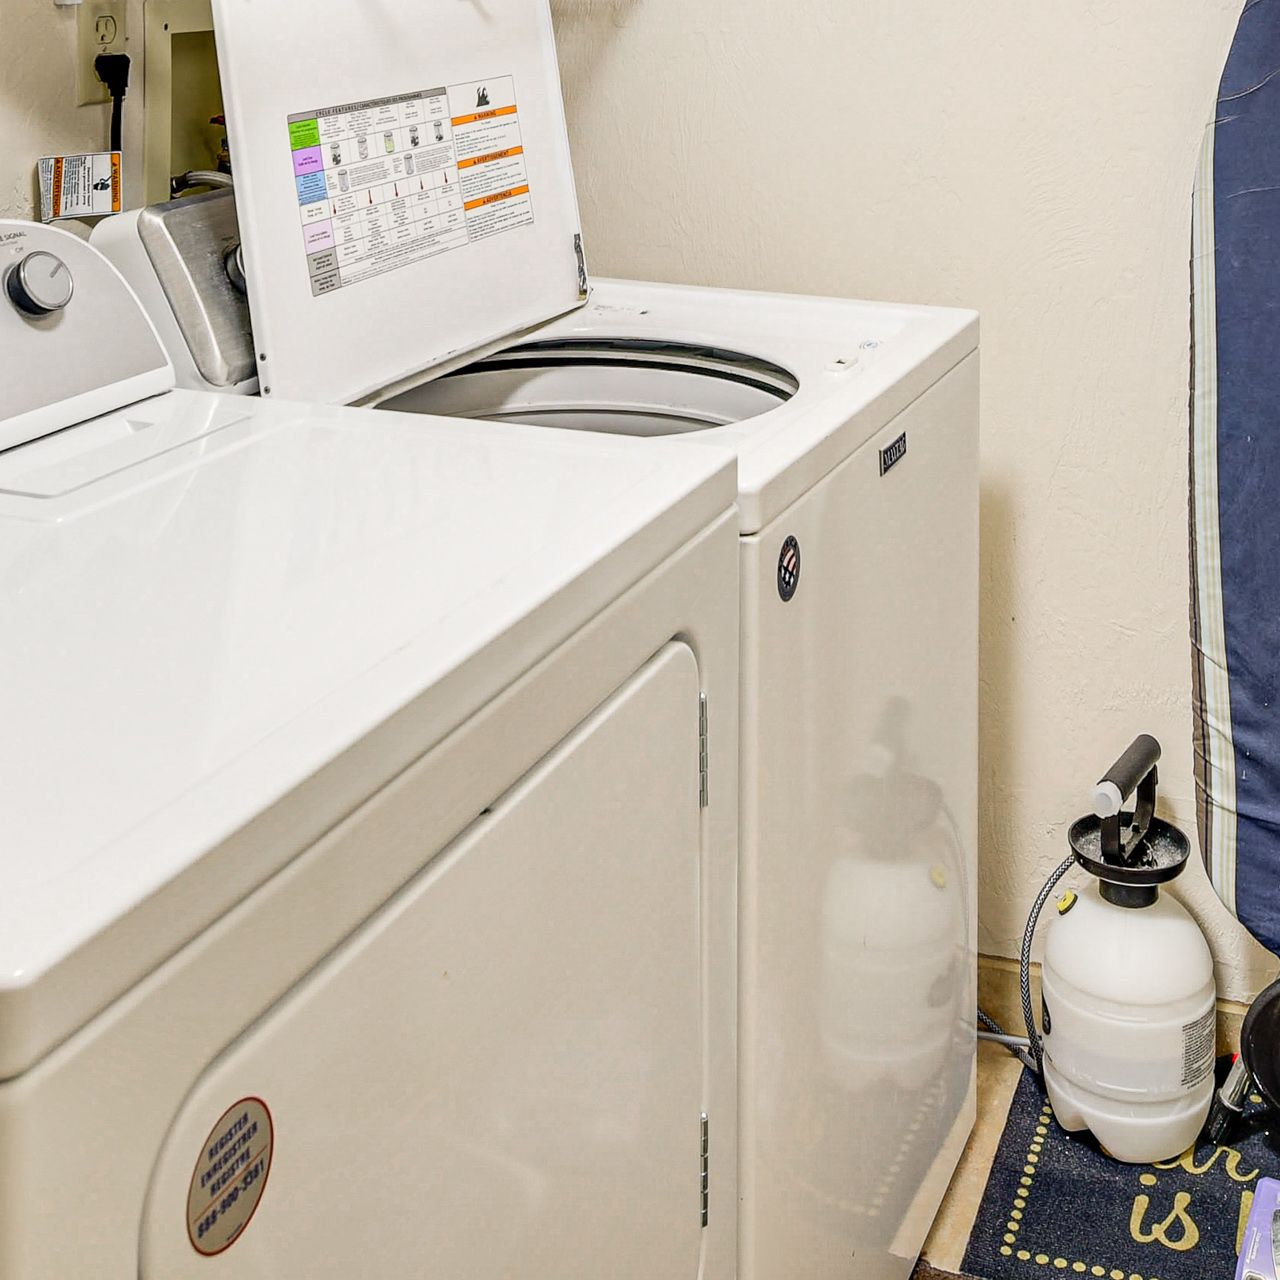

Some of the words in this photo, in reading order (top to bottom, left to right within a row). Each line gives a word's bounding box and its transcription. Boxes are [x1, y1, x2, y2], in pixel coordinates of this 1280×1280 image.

[4, 231, 27, 241] SIGNAL
[883, 437, 906, 468] MAYTAG
[1130, 1173, 1200, 1251] is
